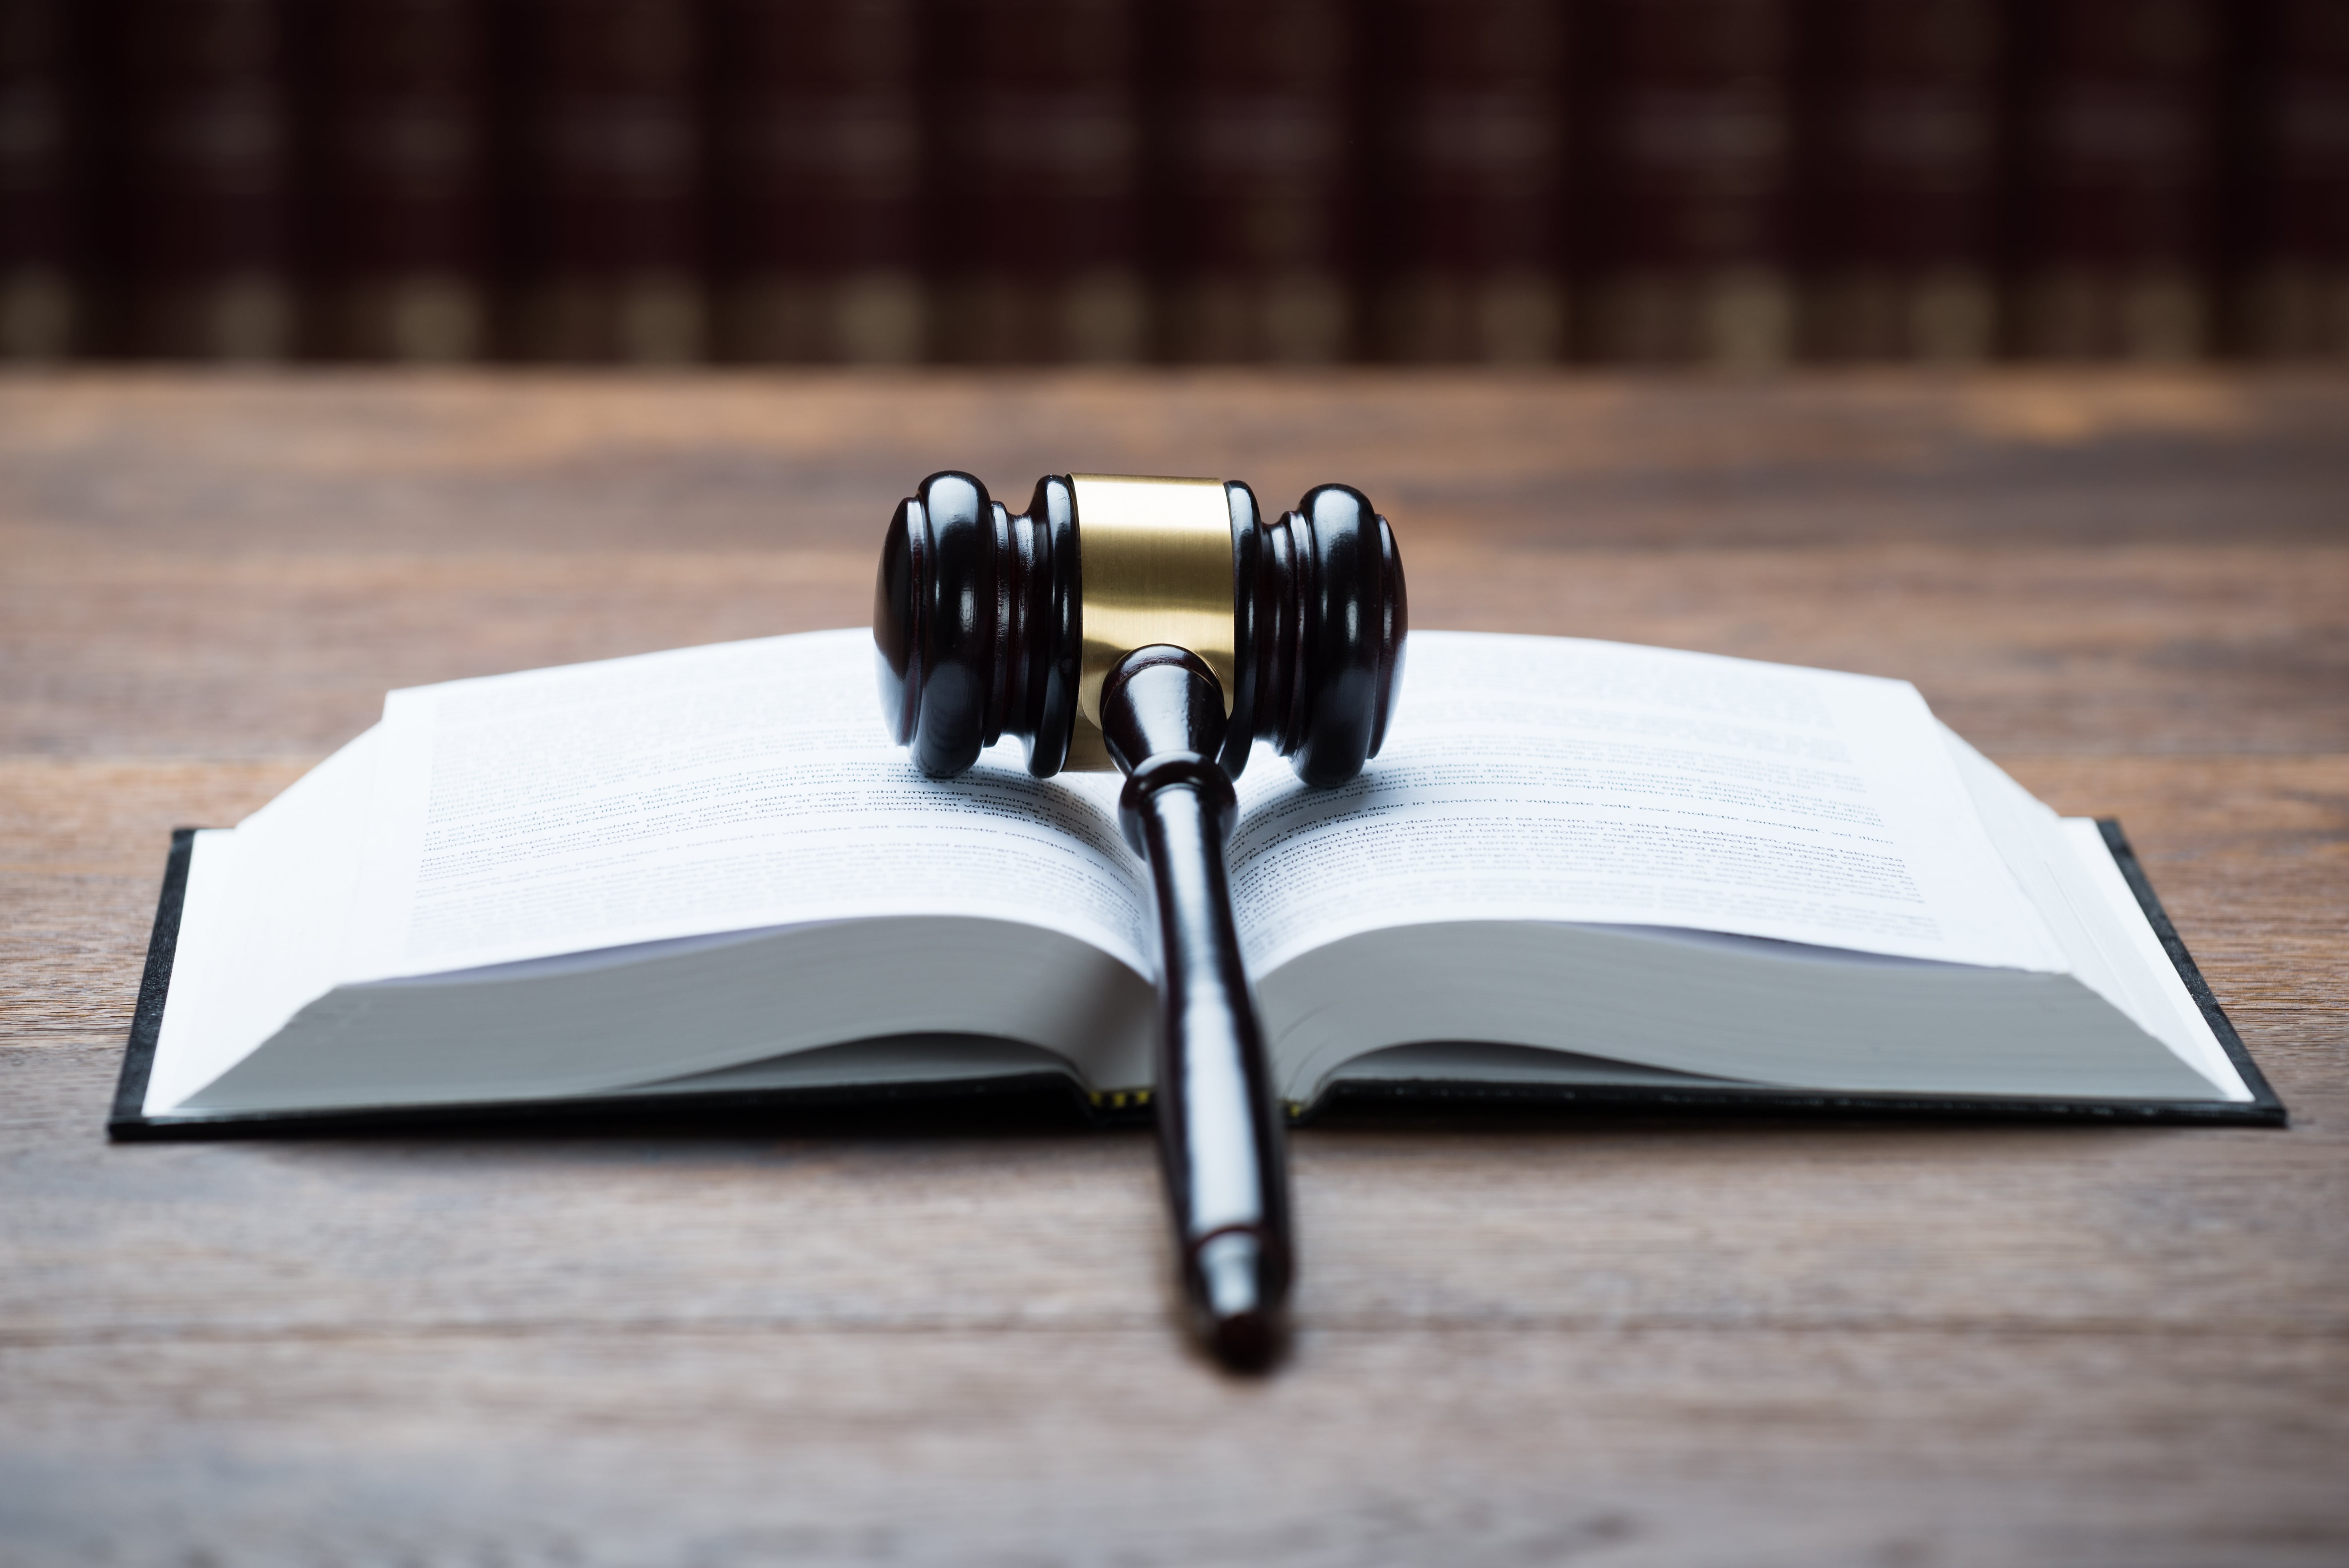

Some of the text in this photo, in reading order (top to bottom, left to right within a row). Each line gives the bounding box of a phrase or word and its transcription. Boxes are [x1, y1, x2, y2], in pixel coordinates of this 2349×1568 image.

[746, 783, 793, 792] delenit
[1005, 786, 1039, 797] nulla
[1276, 806, 1304, 818] quis
[1308, 791, 1362, 807] nostrud
[1368, 785, 1409, 793] exerci
[627, 831, 670, 841] exerci
[675, 823, 718, 832] tation
[723, 811, 808, 824] ullamcorper
[983, 812, 1031, 822] aliquip
[647, 813, 684, 822] nobis
[691, 800, 748, 813] eleifend
[980, 794, 1033, 807] doming
[1057, 812, 1089, 829] quod
[647, 817, 691, 827] Lorem
[699, 807, 741, 817] ipsum
[971, 799, 1040, 814] adipiscing
[1079, 827, 1099, 841] sed
[699, 812, 748, 823] laoreet
[1055, 822, 1081, 835] wisi
[1261, 833, 1280, 845] vel
[1286, 820, 1316, 833] eum
[1324, 810, 1361, 821] iriure
[1678, 811, 1738, 820] molestie
[1859, 836, 1894, 844] illum
[1232, 861, 1245, 874] eu
[1248, 835, 1293, 860] feugiat
[1298, 823, 1331, 835] nulla
[1239, 865, 1260, 881] eos
[1264, 855, 1276, 864] et
[1281, 833, 1340, 855] accusam
[1839, 849, 1902, 862] takimata
[1242, 872, 1259, 886] est
[1263, 850, 1305, 871] Lorem
[1310, 836, 1352, 849] ipsum
[1680, 834, 1757, 845] consetetur
[1764, 844, 1838, 858] sadipscing
[1283, 846, 1332, 867] eirmod
[1337, 836, 1387, 847] tempor
[1658, 837, 1724, 847] aliquyam
[1086, 858, 1104, 870] vel
[1110, 872, 1136, 897] illum
